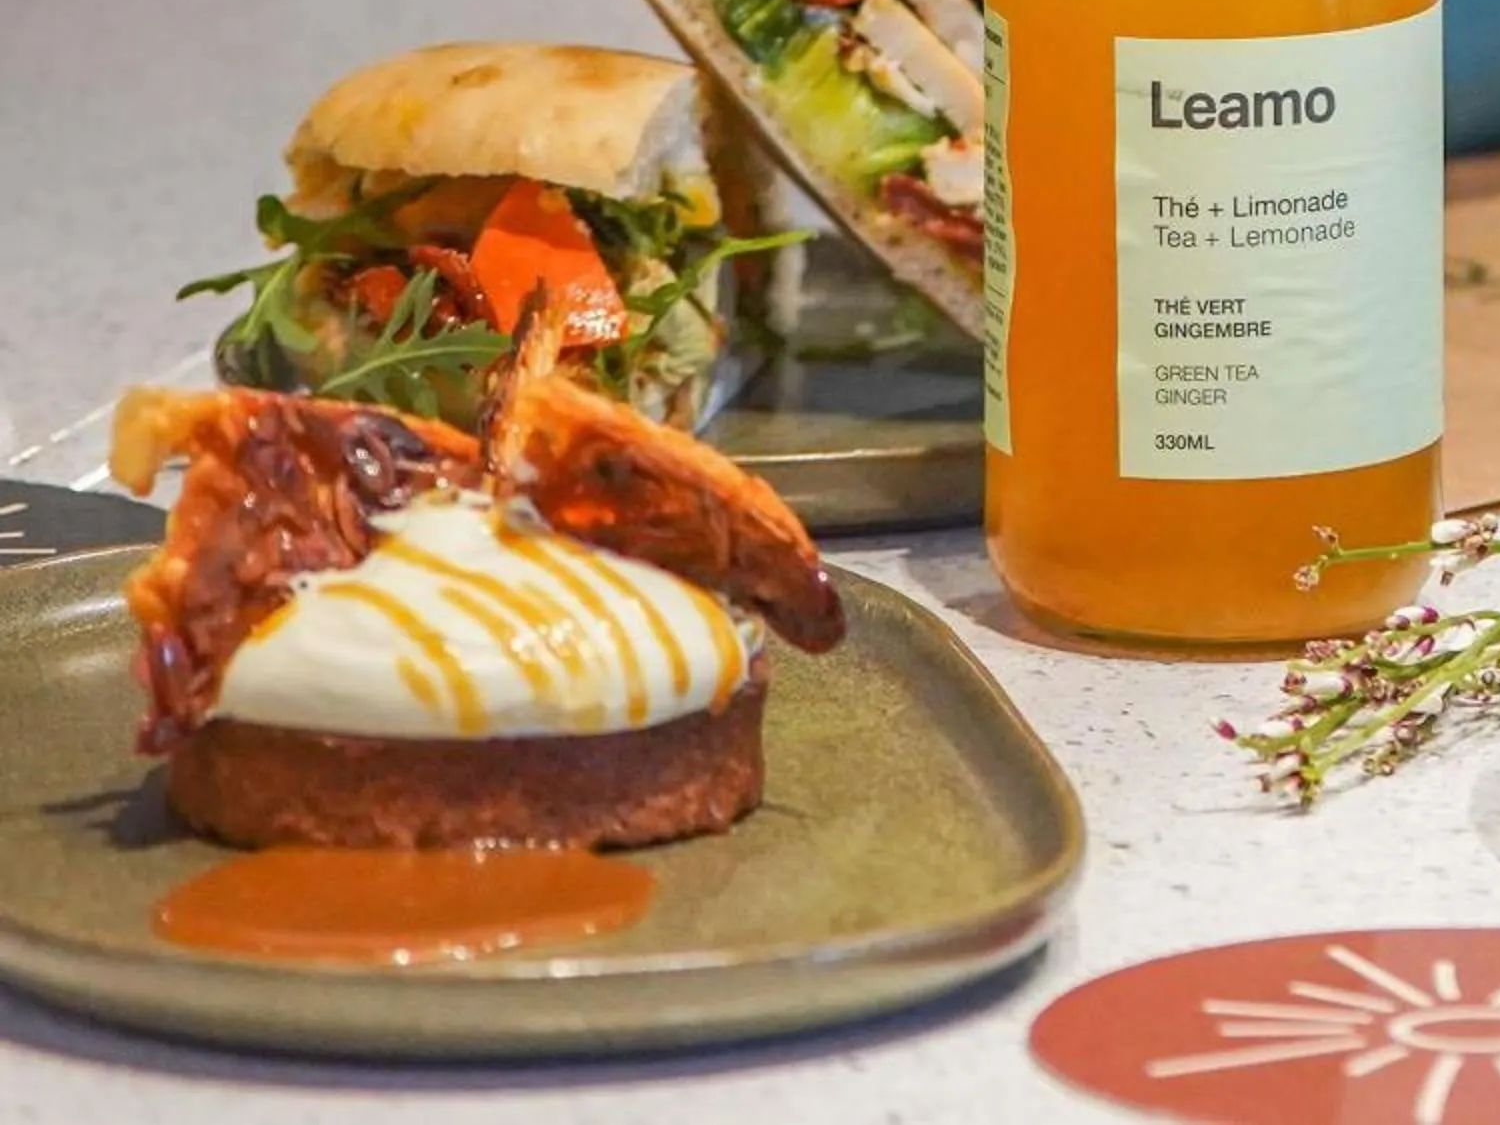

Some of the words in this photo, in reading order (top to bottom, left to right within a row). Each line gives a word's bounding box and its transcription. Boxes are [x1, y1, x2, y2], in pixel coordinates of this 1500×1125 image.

[1150, 81, 1336, 130] Leamo
[1153, 195, 1200, 219] Thé
[1232, 189, 1349, 219] Limonade
[1153, 225, 1198, 249] Tea
[1230, 219, 1356, 249] Lemonade
[1153, 296, 1191, 316] THÉ
[1195, 298, 1246, 316] VERT
[1154, 321, 1272, 340] GINGEMBRE
[1155, 364, 1219, 382] GREEN
[1224, 364, 1260, 381] TEA
[1155, 388, 1228, 406] GINGER
[1154, 434, 1216, 451] 330ML
